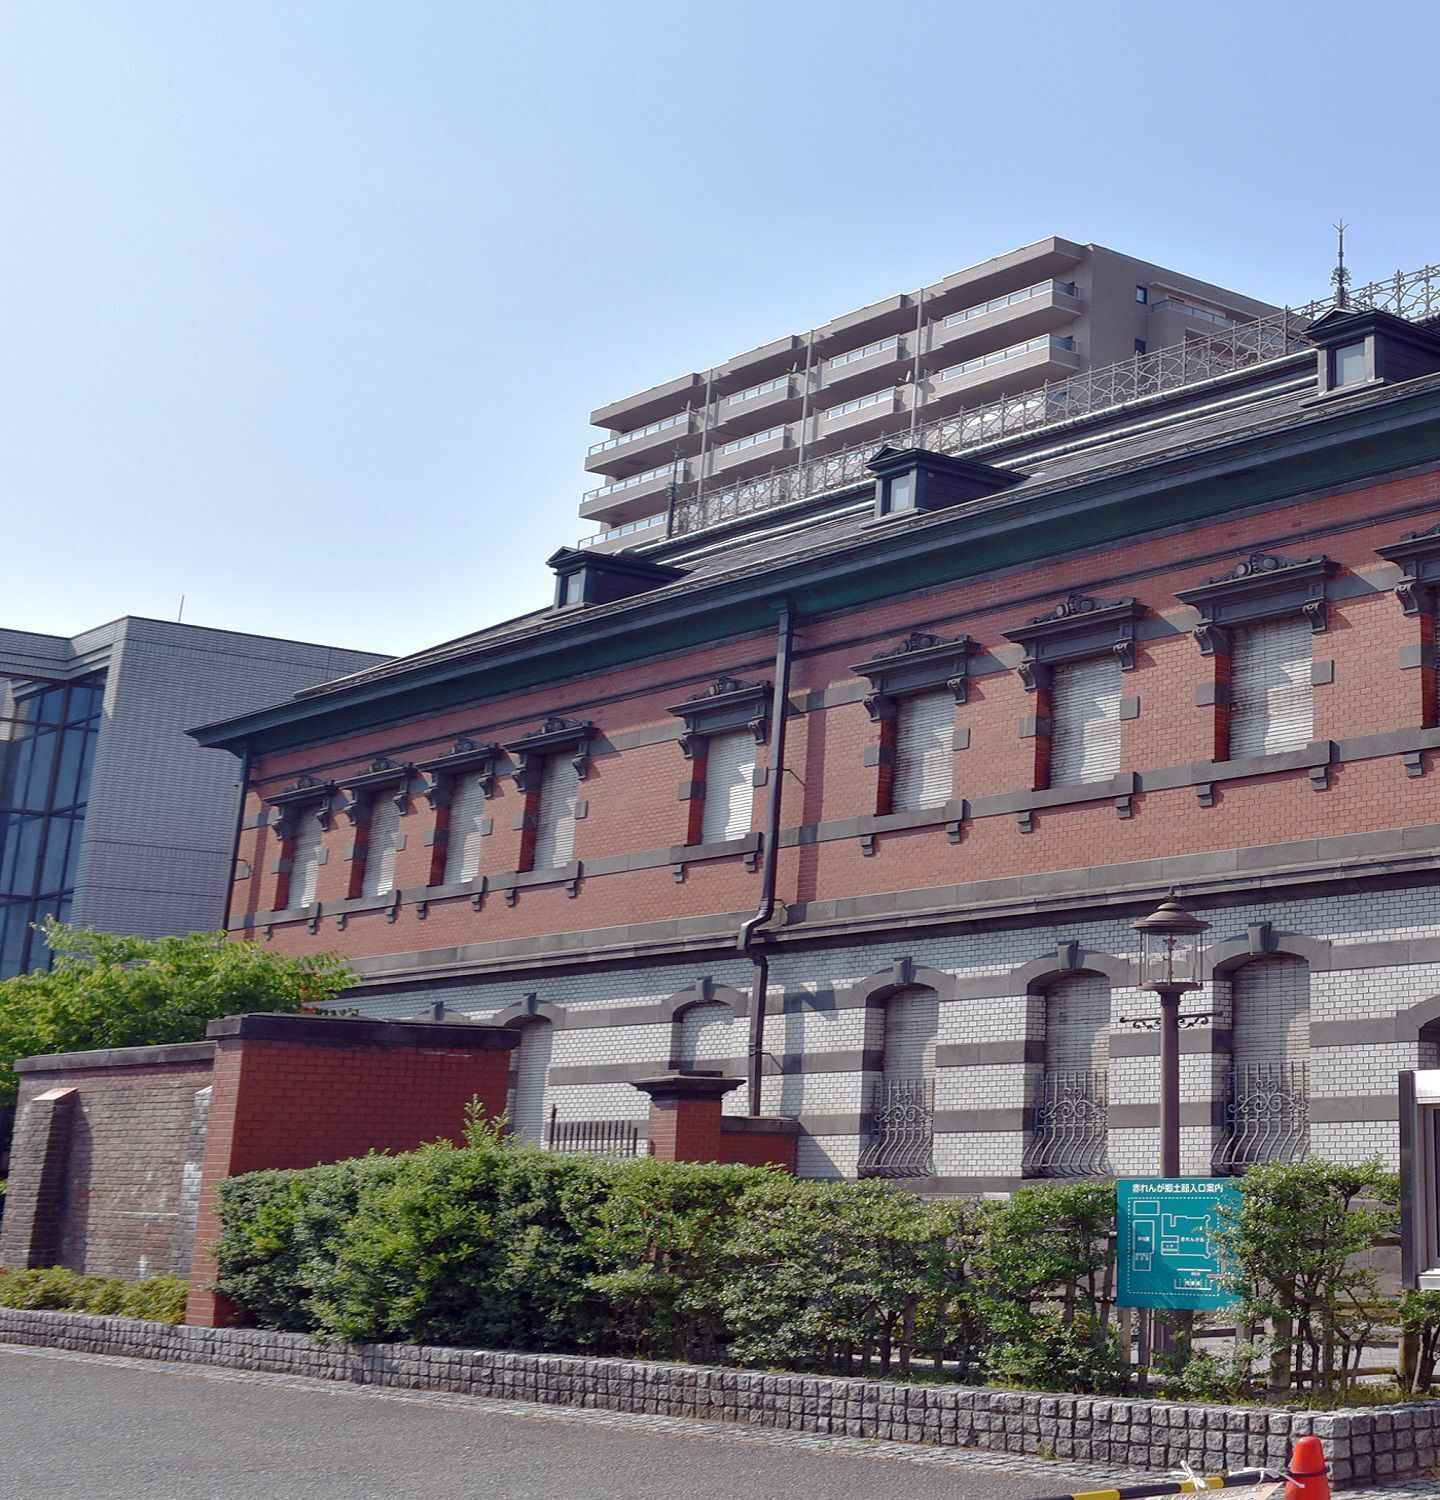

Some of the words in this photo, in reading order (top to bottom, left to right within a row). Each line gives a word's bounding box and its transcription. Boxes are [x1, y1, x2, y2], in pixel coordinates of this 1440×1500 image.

[1132, 1183, 1224, 1193] 赤れんが郷土館入口案内
